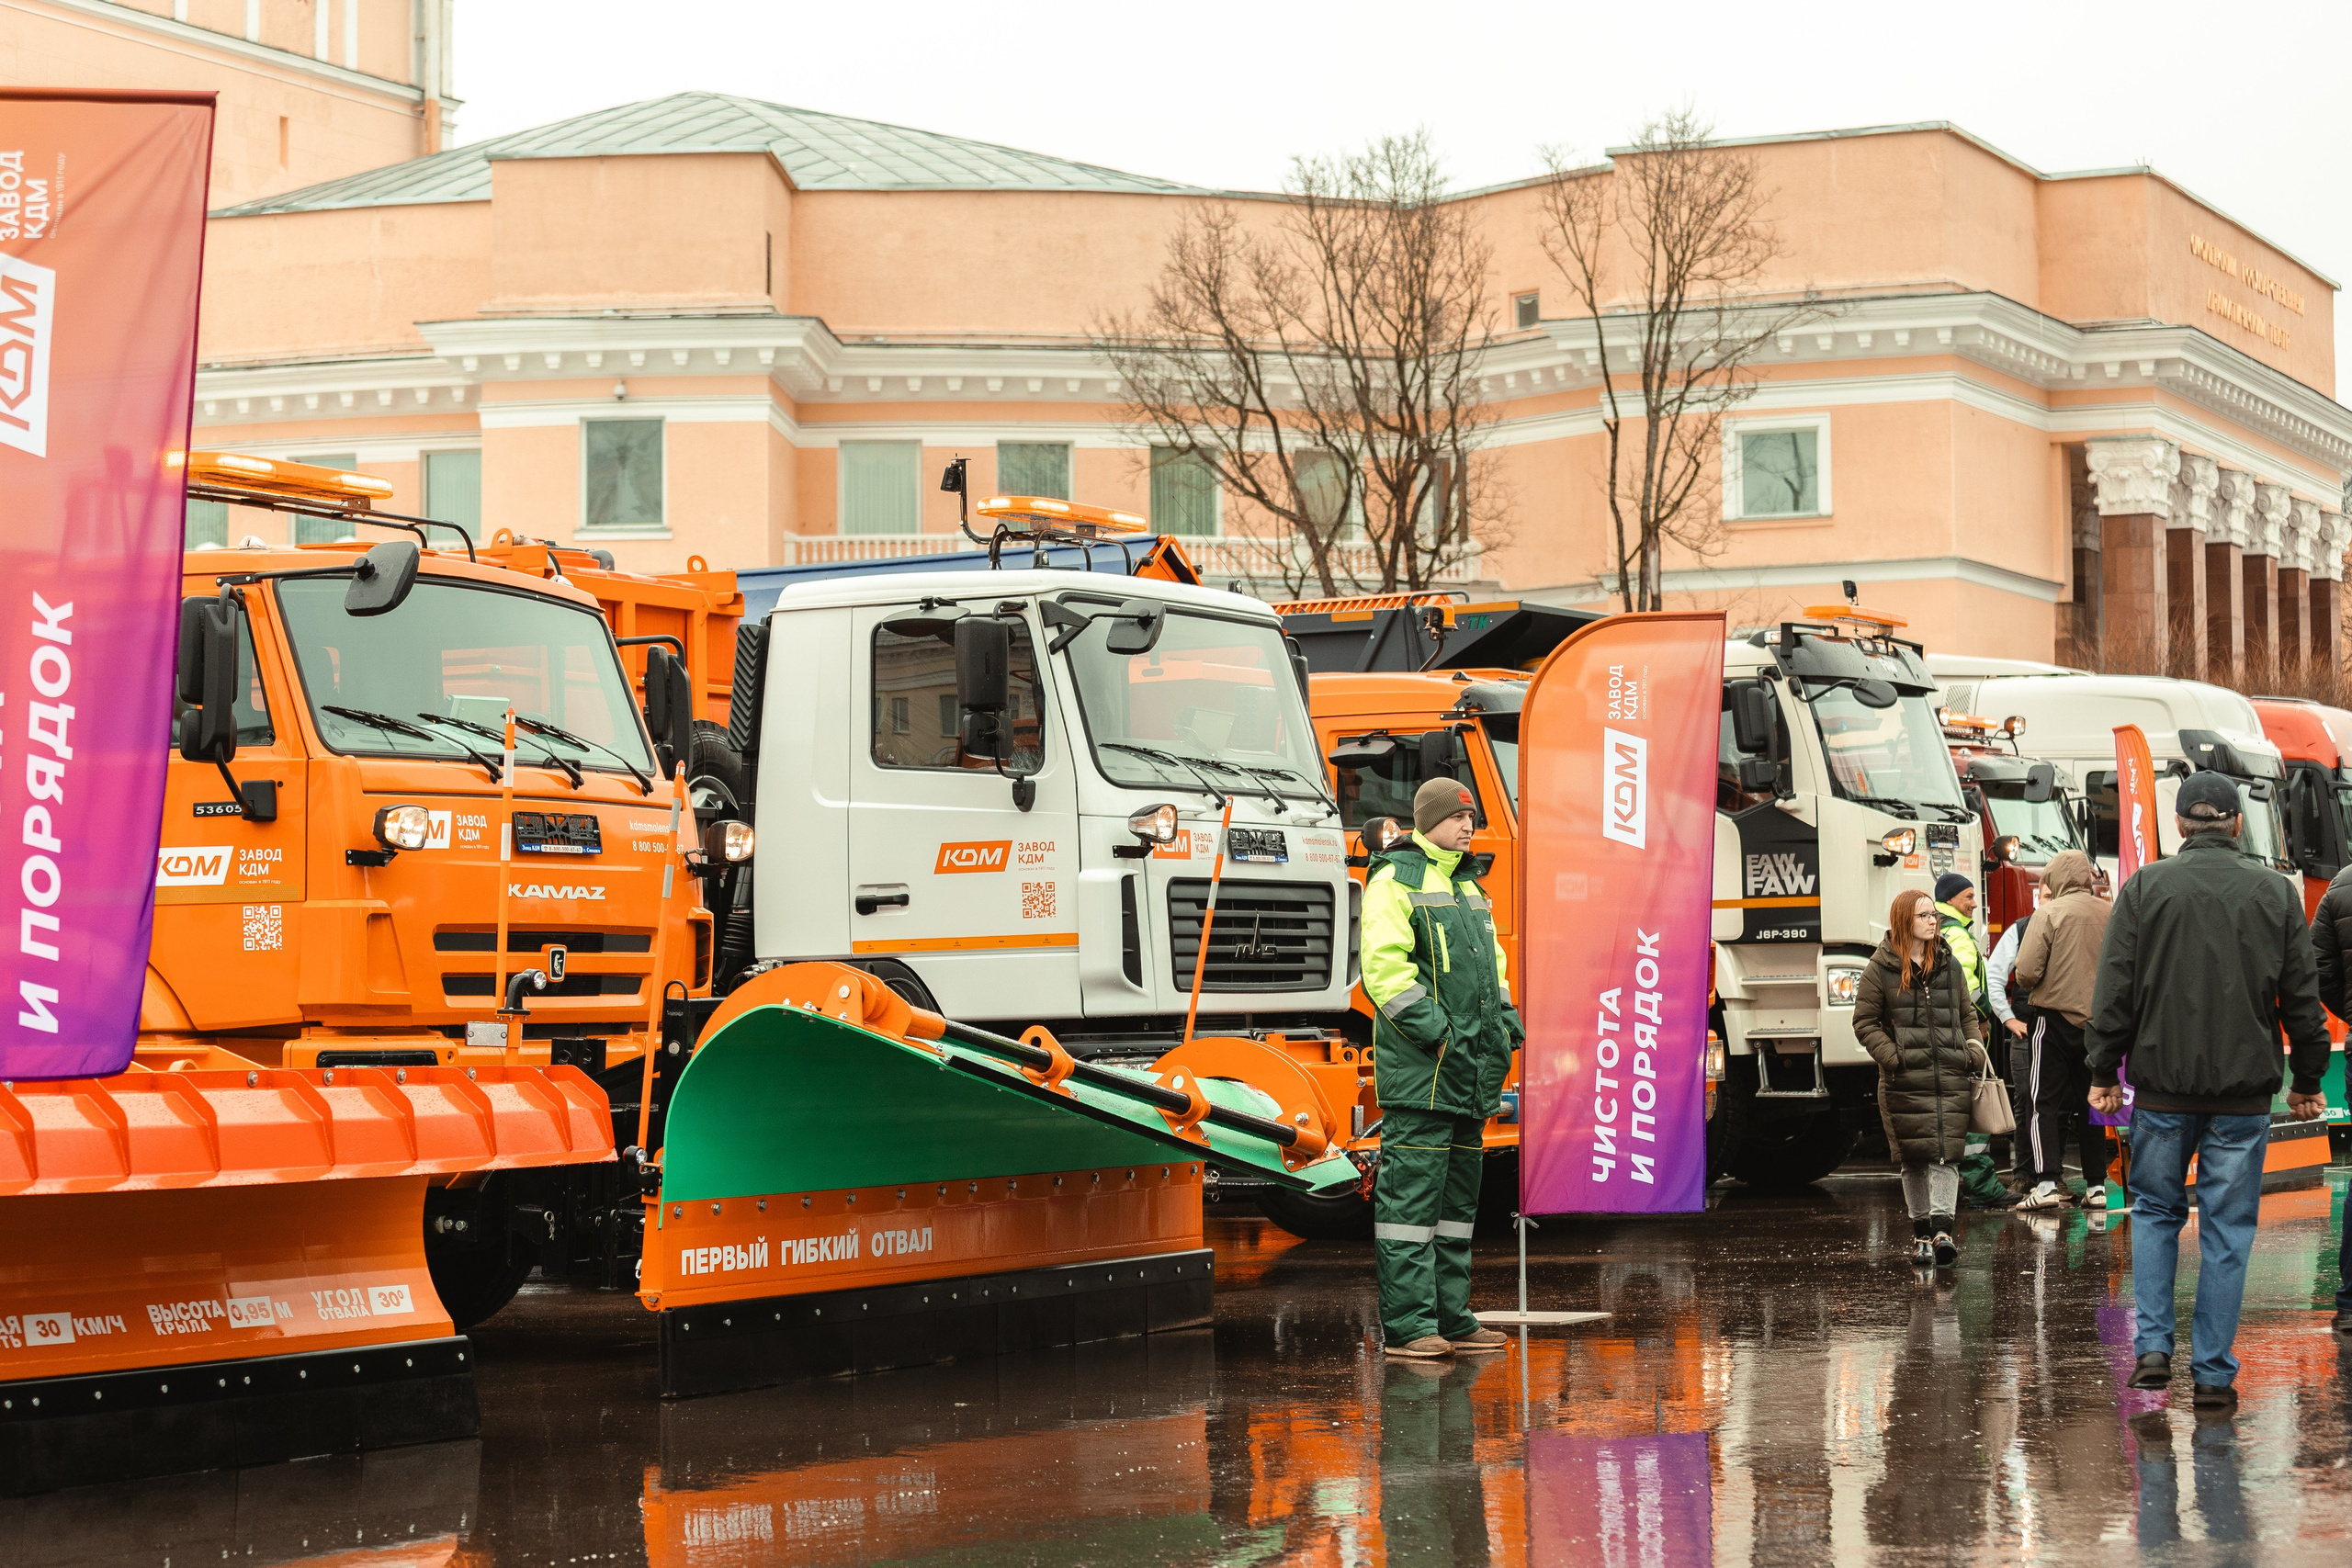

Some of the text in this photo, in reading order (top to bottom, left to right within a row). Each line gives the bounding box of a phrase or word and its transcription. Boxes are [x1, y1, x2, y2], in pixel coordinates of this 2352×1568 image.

[0, 151, 24, 242] ЗАВОД
[23, 179, 51, 239] КДМ
[1608, 664, 1623, 721] ЗАВОД
[1623, 681, 1639, 721] КДМ
[18, 591, 75, 1034] И ПОРЯДОК
[196, 805, 242, 815] 53605
[456, 815, 487, 828] ЗАВОД
[458, 829, 481, 842] КДМ
[1193, 832, 1214, 843] ЗАВОД
[239, 849, 282, 862] ЗАВОД
[632, 840, 684, 855] 8 800 500--67
[1018, 841, 1056, 853] ЗАВОД
[1195, 844, 1210, 855] КДМ
[1018, 854, 1045, 864] КДМ
[1305, 852, 1309, 862] 8
[1747, 853, 1795, 867] FAW
[239, 863, 269, 876] КДМ
[508, 883, 606, 900] KAMAZ
[1747, 874, 1815, 896] FAW
[1756, 929, 1807, 939] J6P-390
[1631, 927, 1663, 1185] И ПОРЯДОК
[1592, 987, 1622, 1183] ЧИСТОТА
[681, 1227, 933, 1276] ПЕРВЫЙ ГИБКИЙ ОТВАЛ
[311, 1288, 365, 1309] УГОЛ
[146, 1300, 226, 1323] ВЫСОТА
[231, 1301, 293, 1324] 0,95 М
[318, 1305, 371, 1321] ОТВАЛА
[35, 1319, 61, 1337] 30
[73, 1314, 127, 1337] КМ/Ч
[153, 1319, 212, 1336] КРЫЛА
